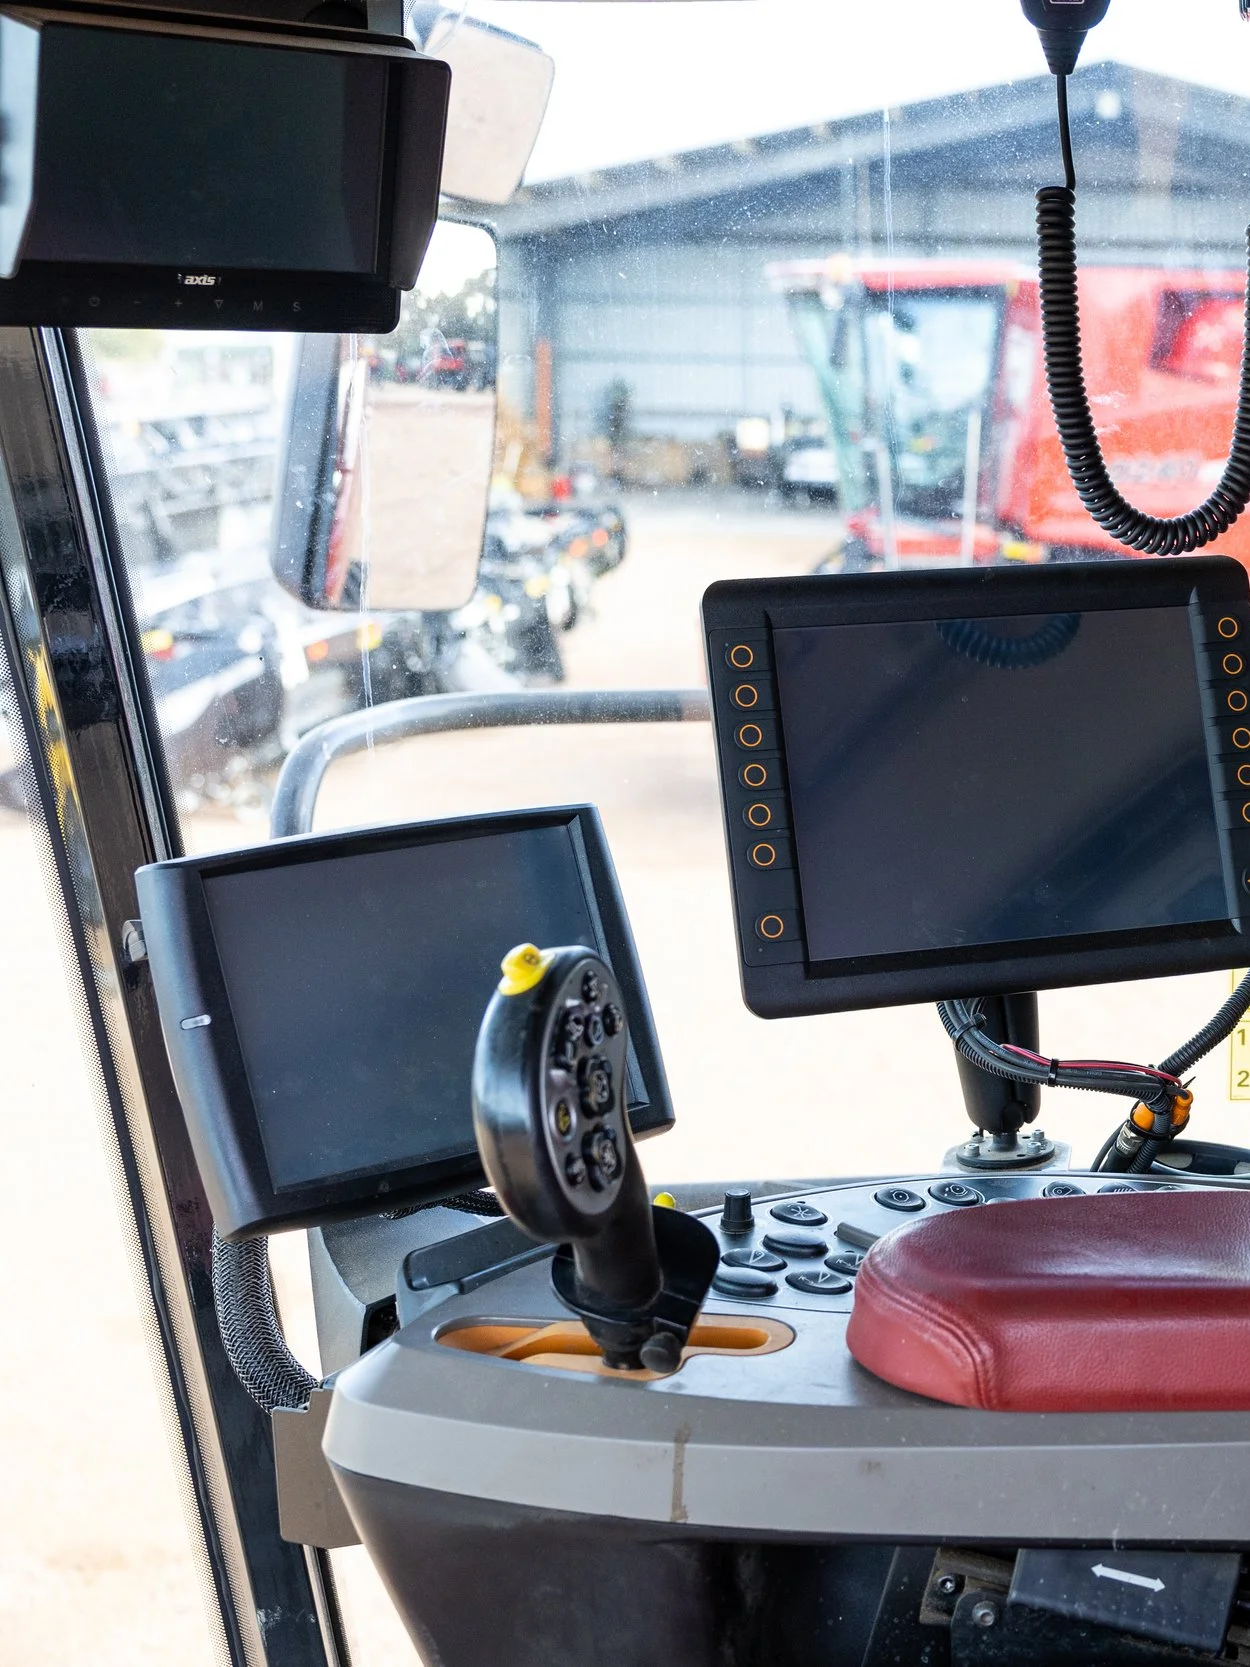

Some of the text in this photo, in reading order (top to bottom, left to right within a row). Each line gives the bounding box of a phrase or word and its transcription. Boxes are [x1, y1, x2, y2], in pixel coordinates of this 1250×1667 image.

[184, 275, 216, 286] axis
[253, 301, 264, 311] M
[293, 301, 301, 312] S
[1237, 1028, 1245, 1046] 1
[1237, 1070, 1250, 1087] 2
